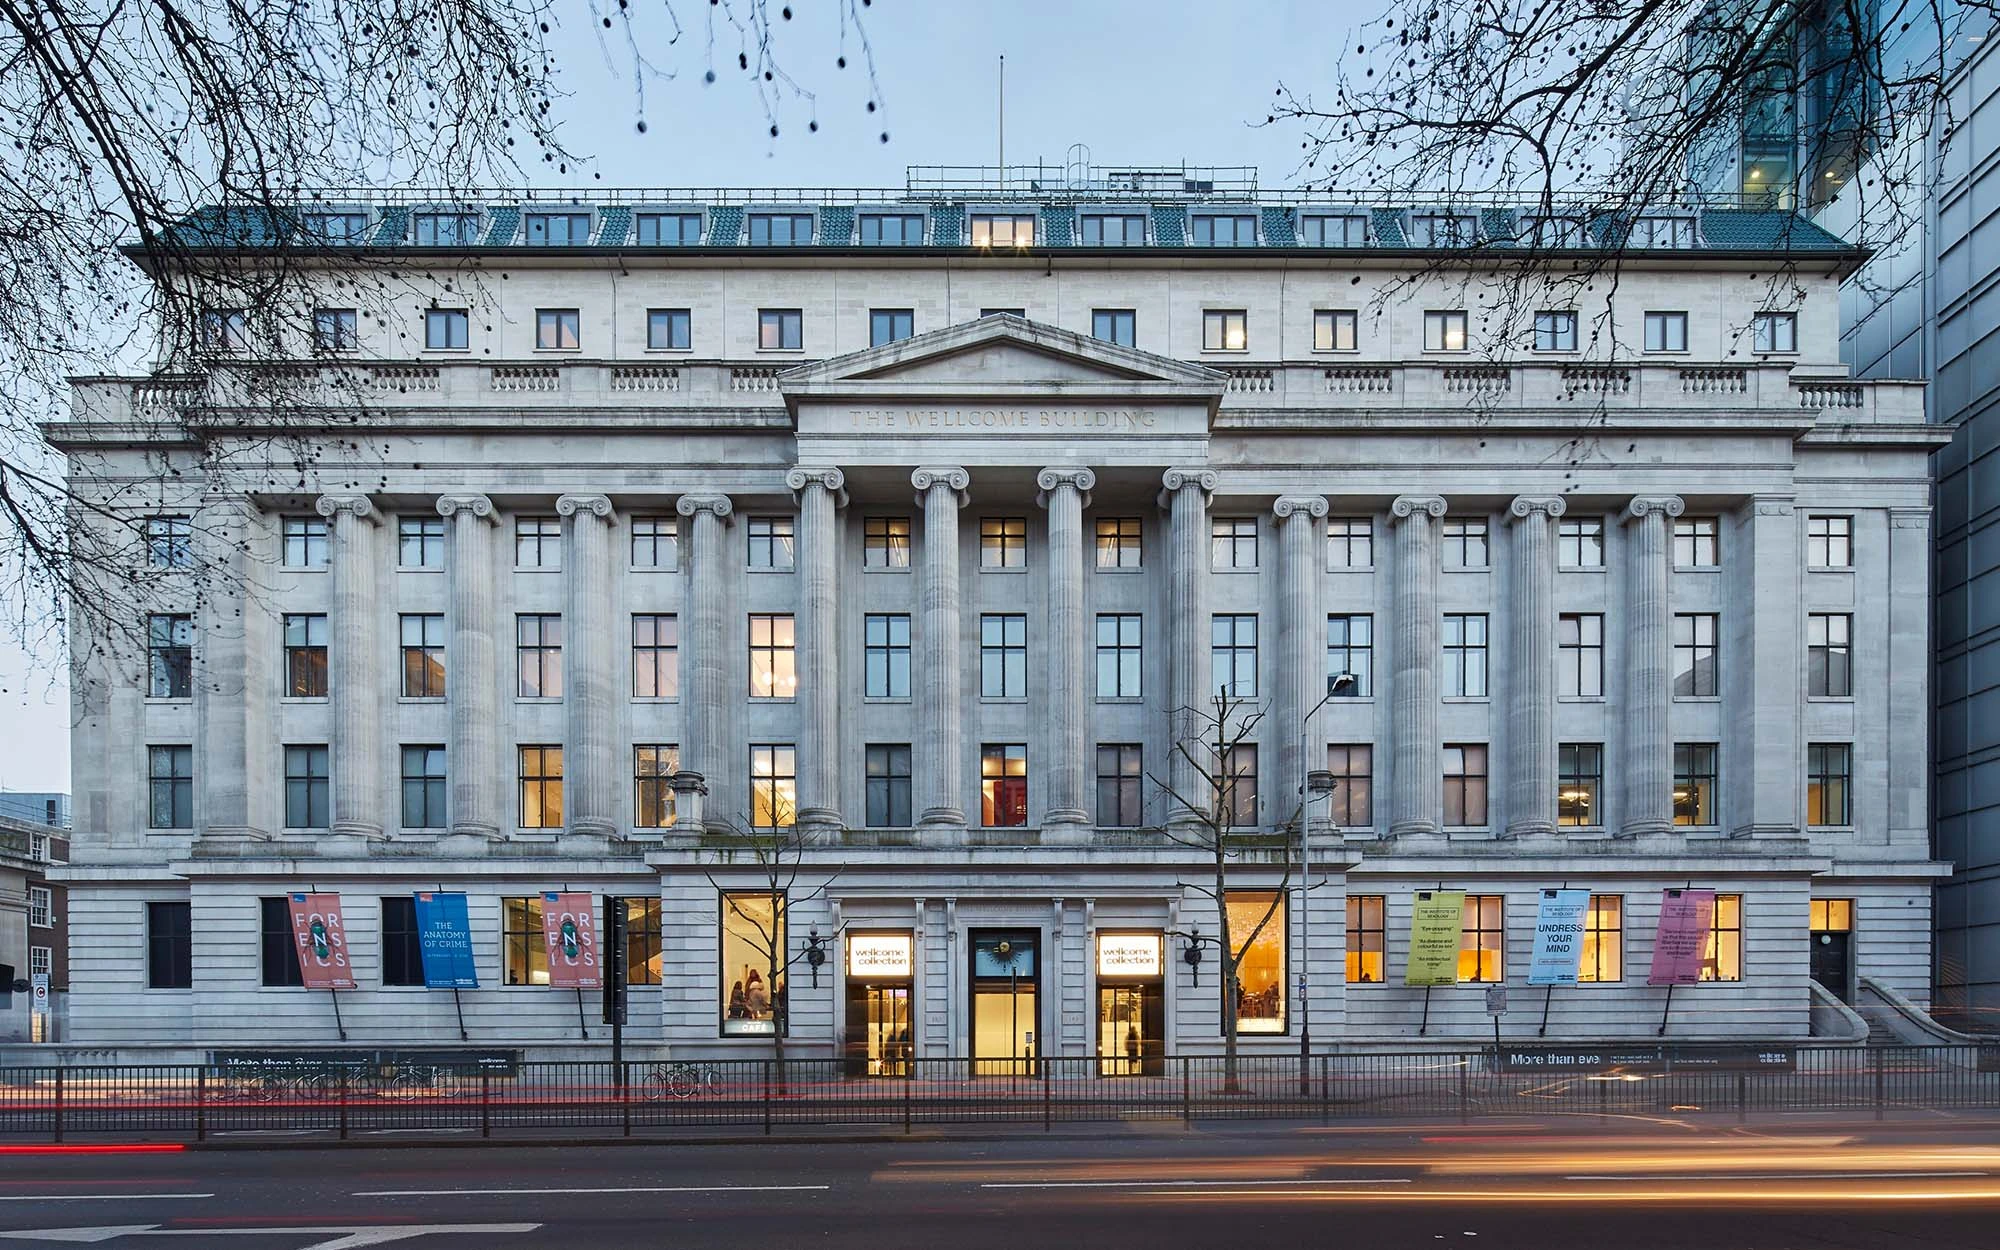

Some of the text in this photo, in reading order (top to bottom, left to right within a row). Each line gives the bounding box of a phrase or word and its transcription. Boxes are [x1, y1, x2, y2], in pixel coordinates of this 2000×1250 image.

[849, 410, 1155, 427] THE WELLCOME BUILDING
[435, 922, 453, 930] THE
[1538, 923, 1583, 933] UNDRESS
[423, 931, 467, 939] ANATOMY
[1546, 934, 1573, 943] YOUR
[424, 940, 469, 948] OF CRIME
[1545, 944, 1570, 953] MIND
[1511, 1054, 1544, 1064] More
[1547, 1053, 1575, 1064] than
